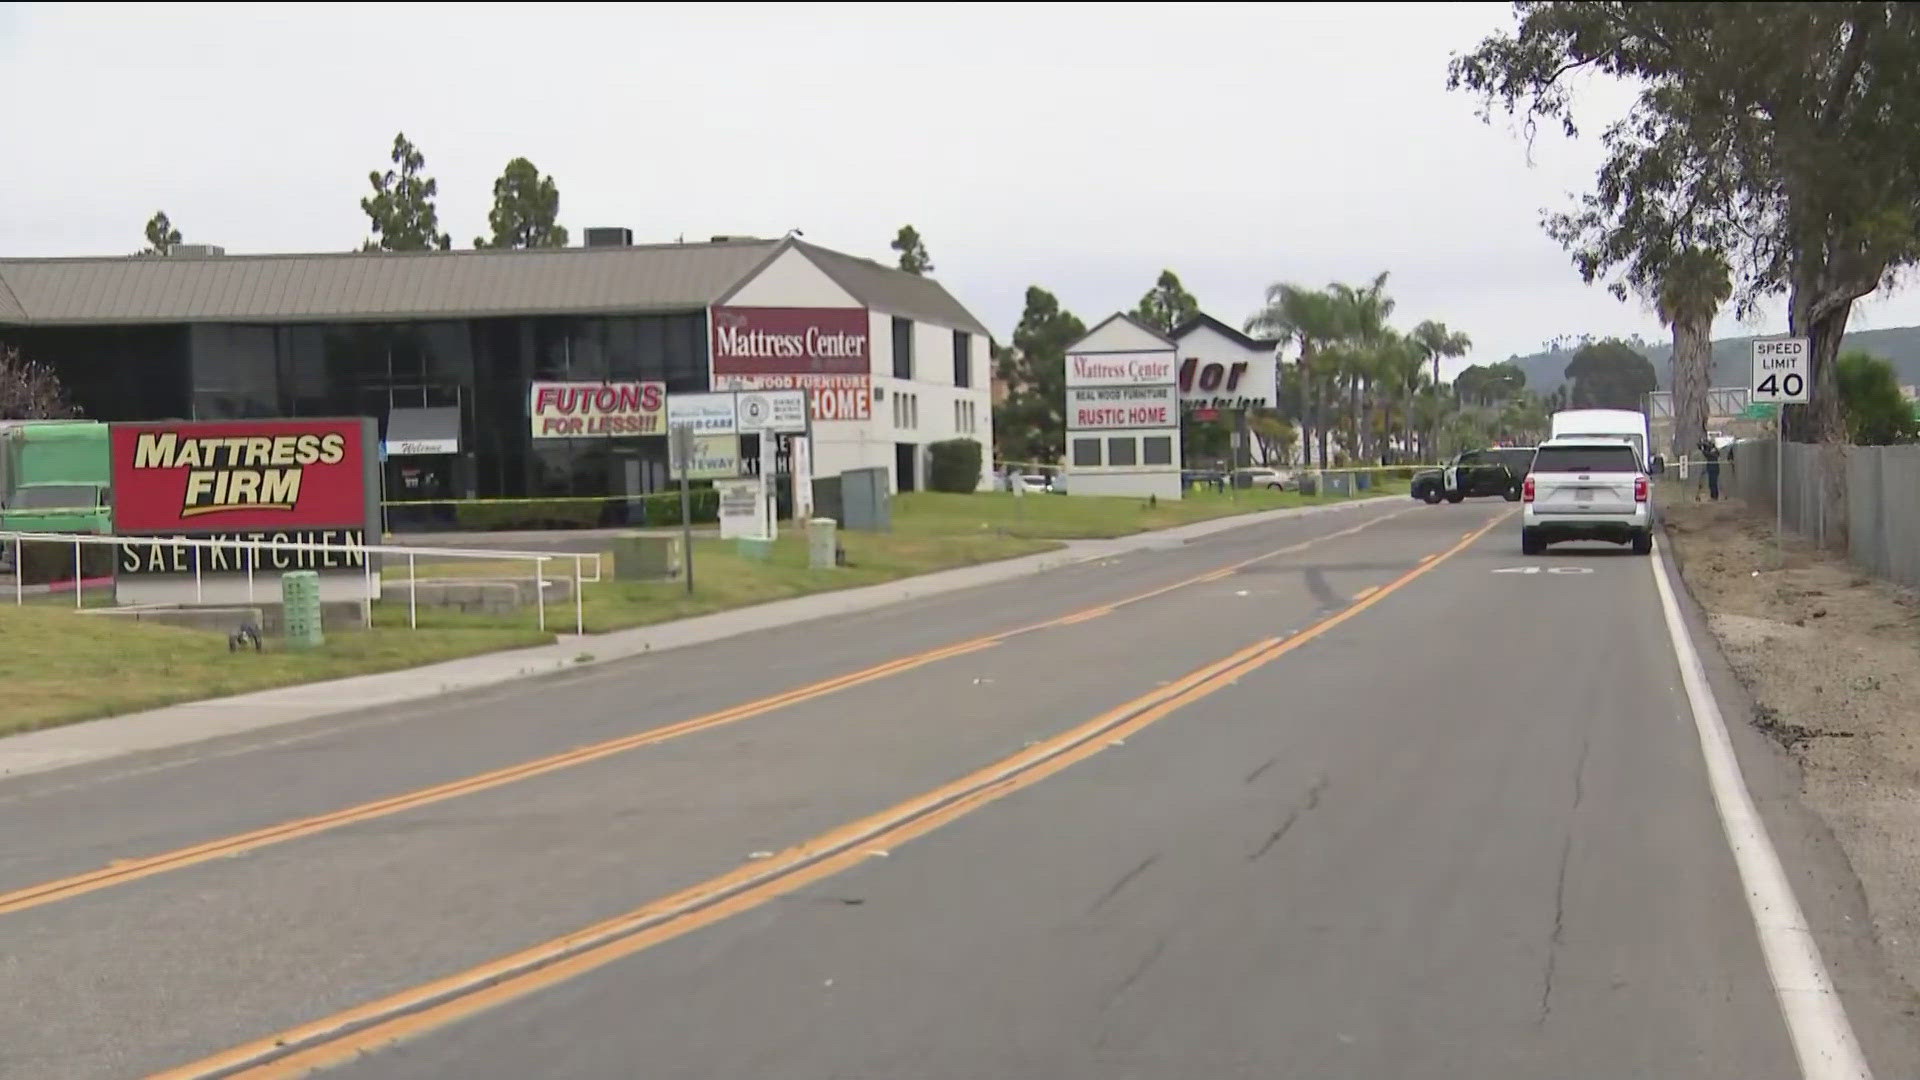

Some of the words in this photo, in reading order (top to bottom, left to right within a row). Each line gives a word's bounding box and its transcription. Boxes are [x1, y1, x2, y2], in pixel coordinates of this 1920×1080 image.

[717, 326, 803, 357] Mattress
[806, 326, 865, 357] Center
[1757, 342, 1803, 355] SPEED
[1128, 360, 1170, 378] Center
[1763, 358, 1797, 370] LIMIT
[1756, 373, 1804, 397] 40
[535, 384, 663, 415] FUTONS
[542, 416, 583, 436] FOR
[587, 413, 658, 435] LESS!!!
[1078, 408, 1125, 425] RUSTIC
[1129, 407, 1167, 424] HOME
[135, 432, 345, 469] MATTRESS
[183, 468, 303, 506] FIRM
[211, 531, 364, 569] KITCHEN
